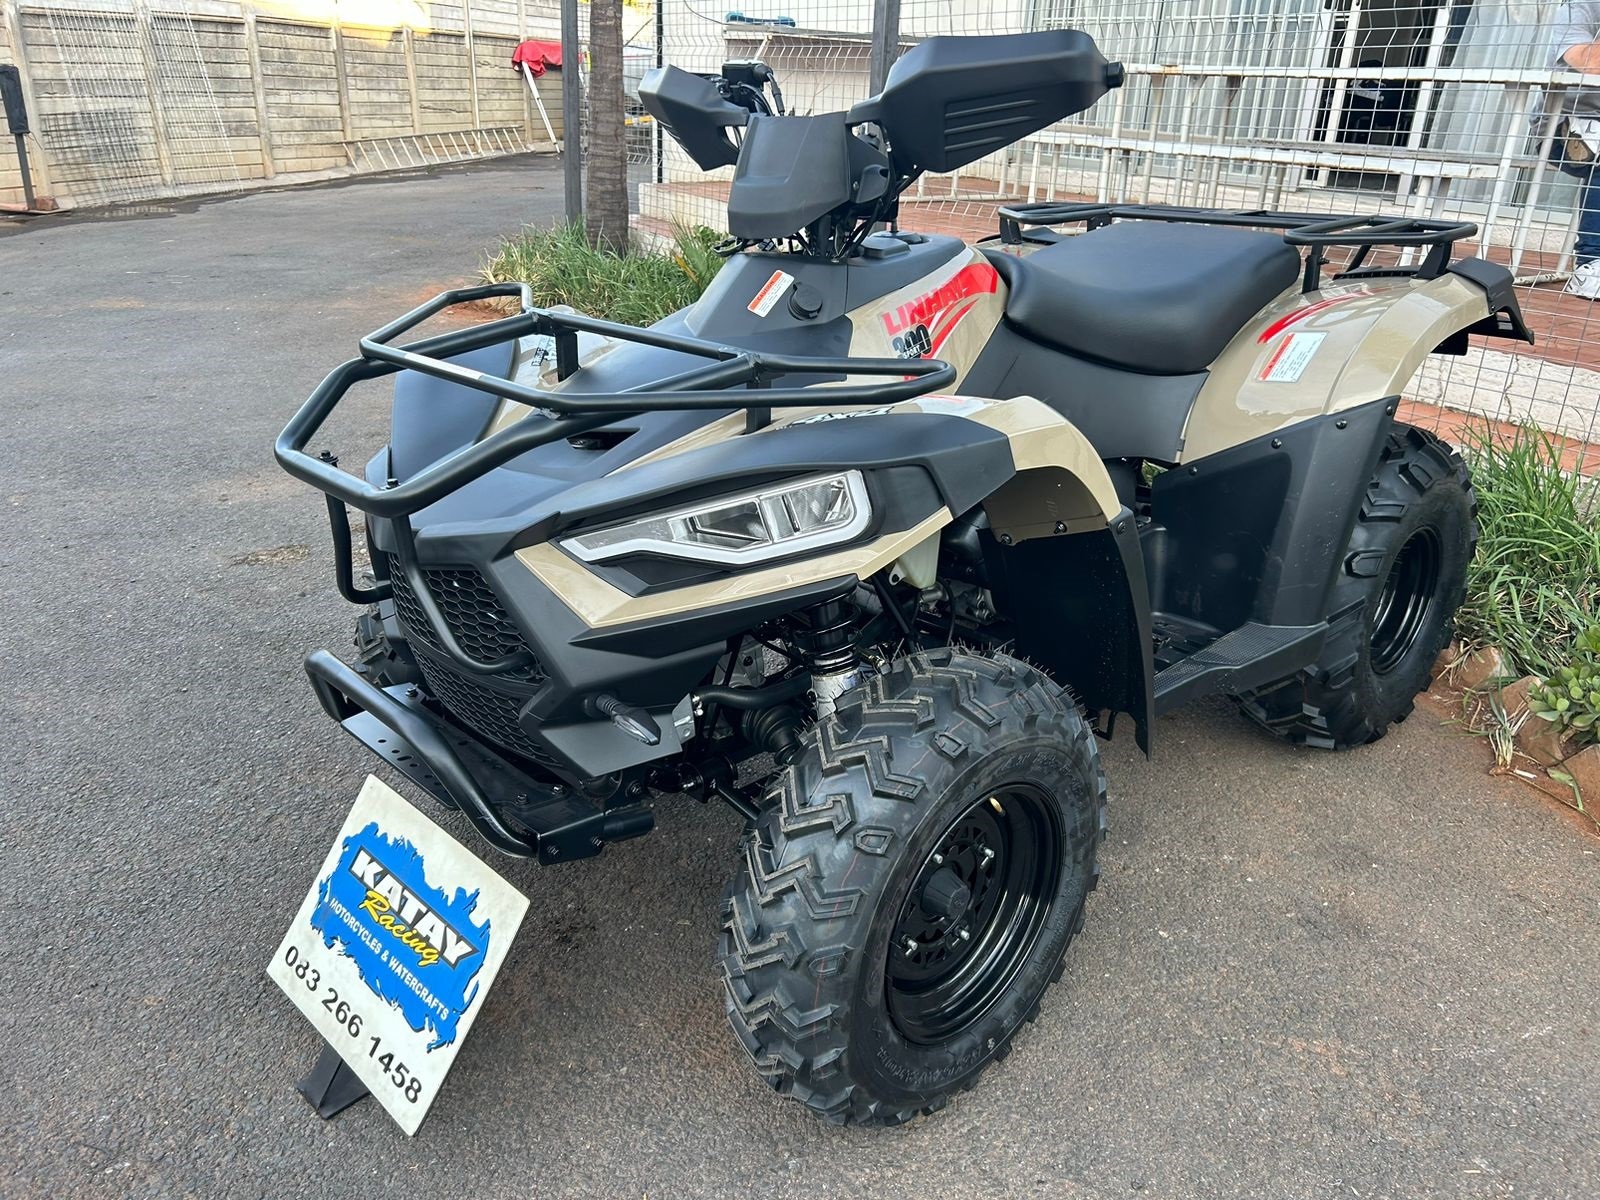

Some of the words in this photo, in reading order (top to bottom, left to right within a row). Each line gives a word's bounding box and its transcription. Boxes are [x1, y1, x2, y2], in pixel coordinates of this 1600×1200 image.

[756, 280, 775, 301] CAUTION
[903, 344, 921, 359] SPORT
[350, 847, 475, 967] KATAY
[358, 890, 440, 967] Racing
[329, 897, 383, 955] MOTORCYCLES
[380, 950, 390, 962] &
[388, 955, 449, 1021] WATERCRAFTS
[285, 945, 321, 992] 083
[321, 987, 364, 1038] 266
[368, 1035, 422, 1104] 1458
